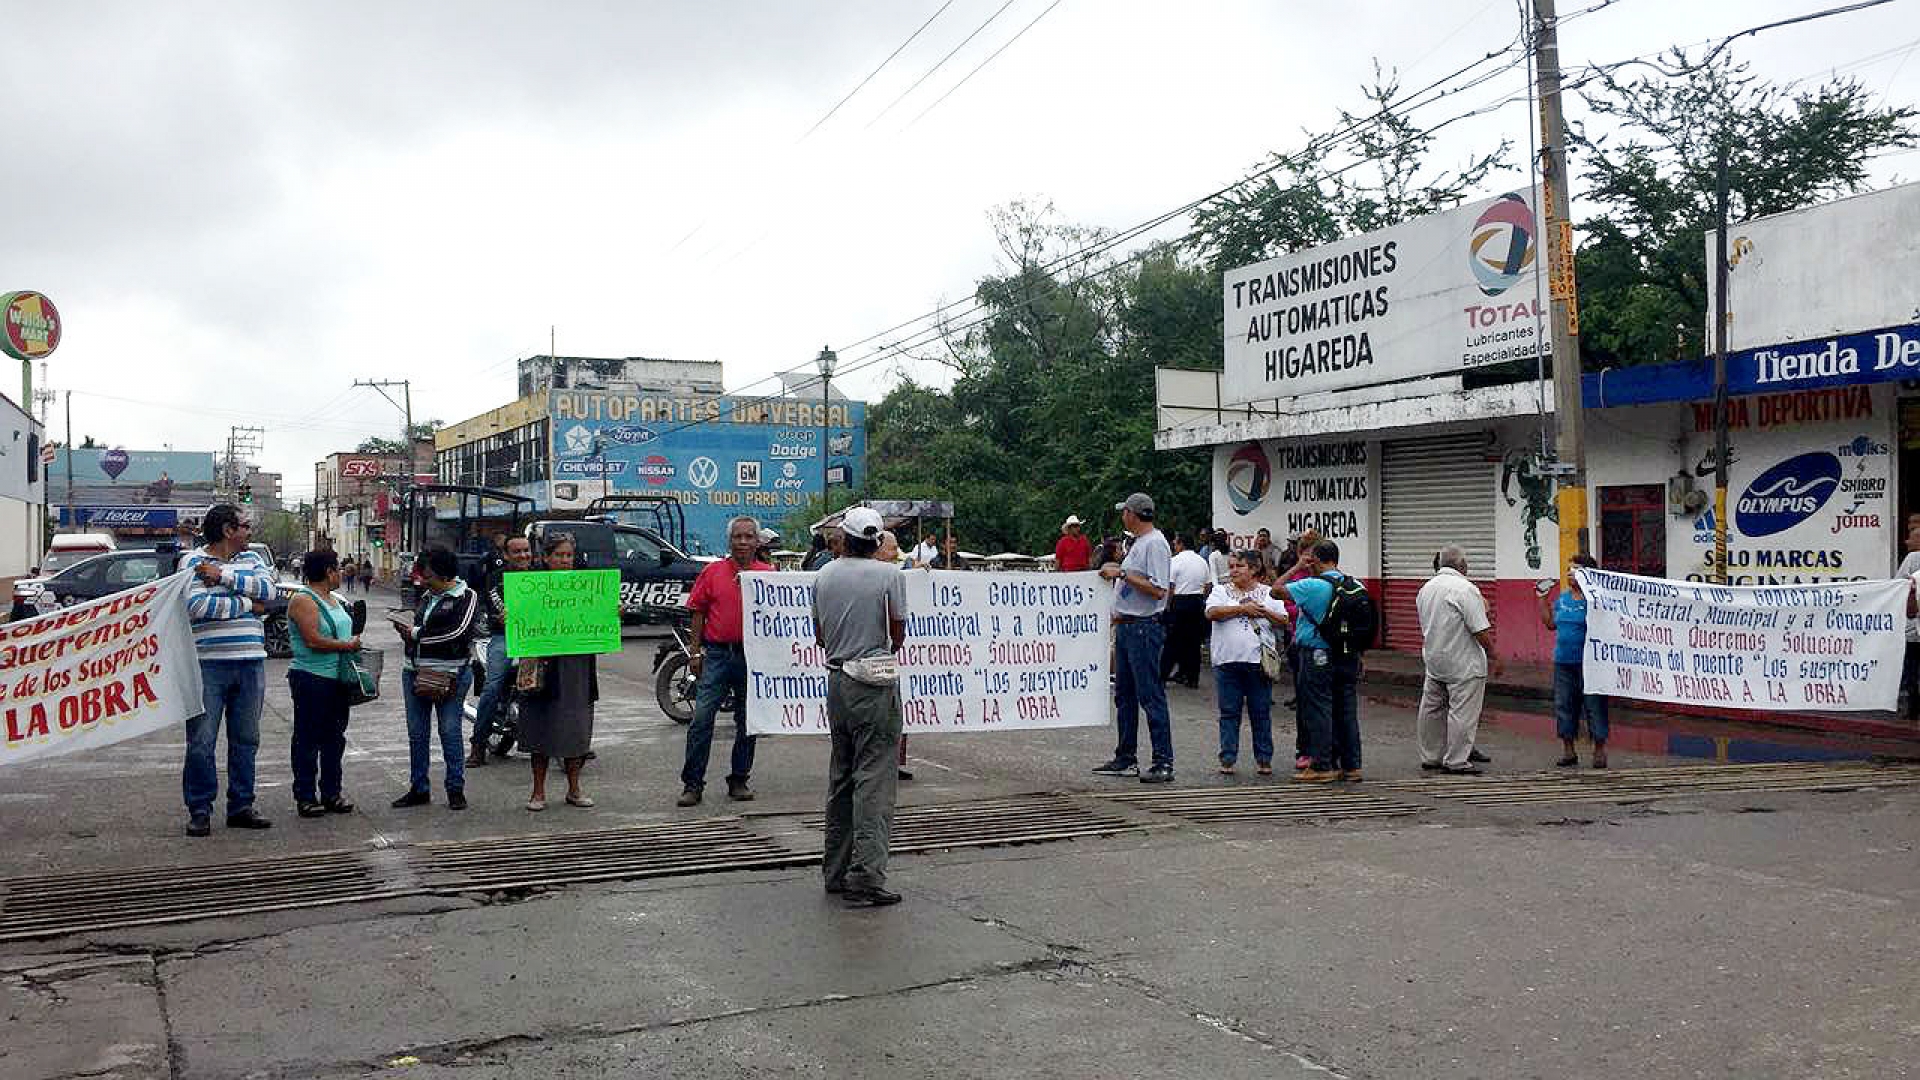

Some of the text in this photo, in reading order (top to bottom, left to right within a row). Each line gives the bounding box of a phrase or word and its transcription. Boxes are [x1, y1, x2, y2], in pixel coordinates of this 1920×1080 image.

[1233, 241, 1397, 309] TRANSMISIONES
[1247, 286, 1389, 344] AUTOMATICAS
[1464, 299, 1547, 328] TOTAL
[1466, 326, 1534, 347] Lubricantes
[1265, 332, 1373, 382] HIGAREDA
[1754, 342, 1860, 384] Tienda
[556, 395, 854, 427] AUTOPARTES UNIVERSAL
[1758, 385, 1873, 427] DEPORTIVA
[769, 443, 817, 458] Dodge
[1277, 441, 1367, 469] TRANSMISIONES
[638, 466, 675, 476] NISSAN
[740, 461, 757, 480] GM
[708, 491, 740, 505] TODO
[746, 491, 779, 506] PARA
[1284, 477, 1368, 502] AUTOMATICAS
[106, 510, 148, 522] telcel
[1739, 497, 1817, 514] OLYMPUS
[1288, 511, 1359, 539] HIGAREDA
[1227, 533, 1255, 549] TOT
[1704, 550, 1843, 567] SLO MARCAS
[620, 582, 684, 595] OLICIA
[933, 582, 962, 607] los
[989, 581, 1094, 607] Gobiernos:
[992, 614, 1001, 640] y
[1013, 615, 1023, 636] a
[1037, 611, 1098, 638] Conagua
[1704, 605, 1779, 630] Municipal
[1785, 613, 1796, 630] y
[1804, 613, 1814, 628] a
[1826, 608, 1894, 635] Conagua
[897, 641, 972, 667] ueremos
[989, 639, 1056, 665] Solucion
[1689, 626, 1766, 652] Queremos
[1783, 631, 1854, 655] Solucion
[1668, 649, 1685, 673] del
[1693, 652, 1744, 676] puente
[14, 673, 39, 698] de
[44, 668, 71, 693] los
[752, 670, 828, 699] Termina
[910, 669, 963, 699] puente
[1617, 666, 1849, 705] NO MAS DEMORA A LA OBRA
[6, 702, 49, 742] LA
[781, 702, 804, 728] NO
[902, 698, 940, 727] ORA
[954, 698, 965, 725] A
[983, 699, 1001, 723] LA
[1017, 695, 1060, 720] OBRA
